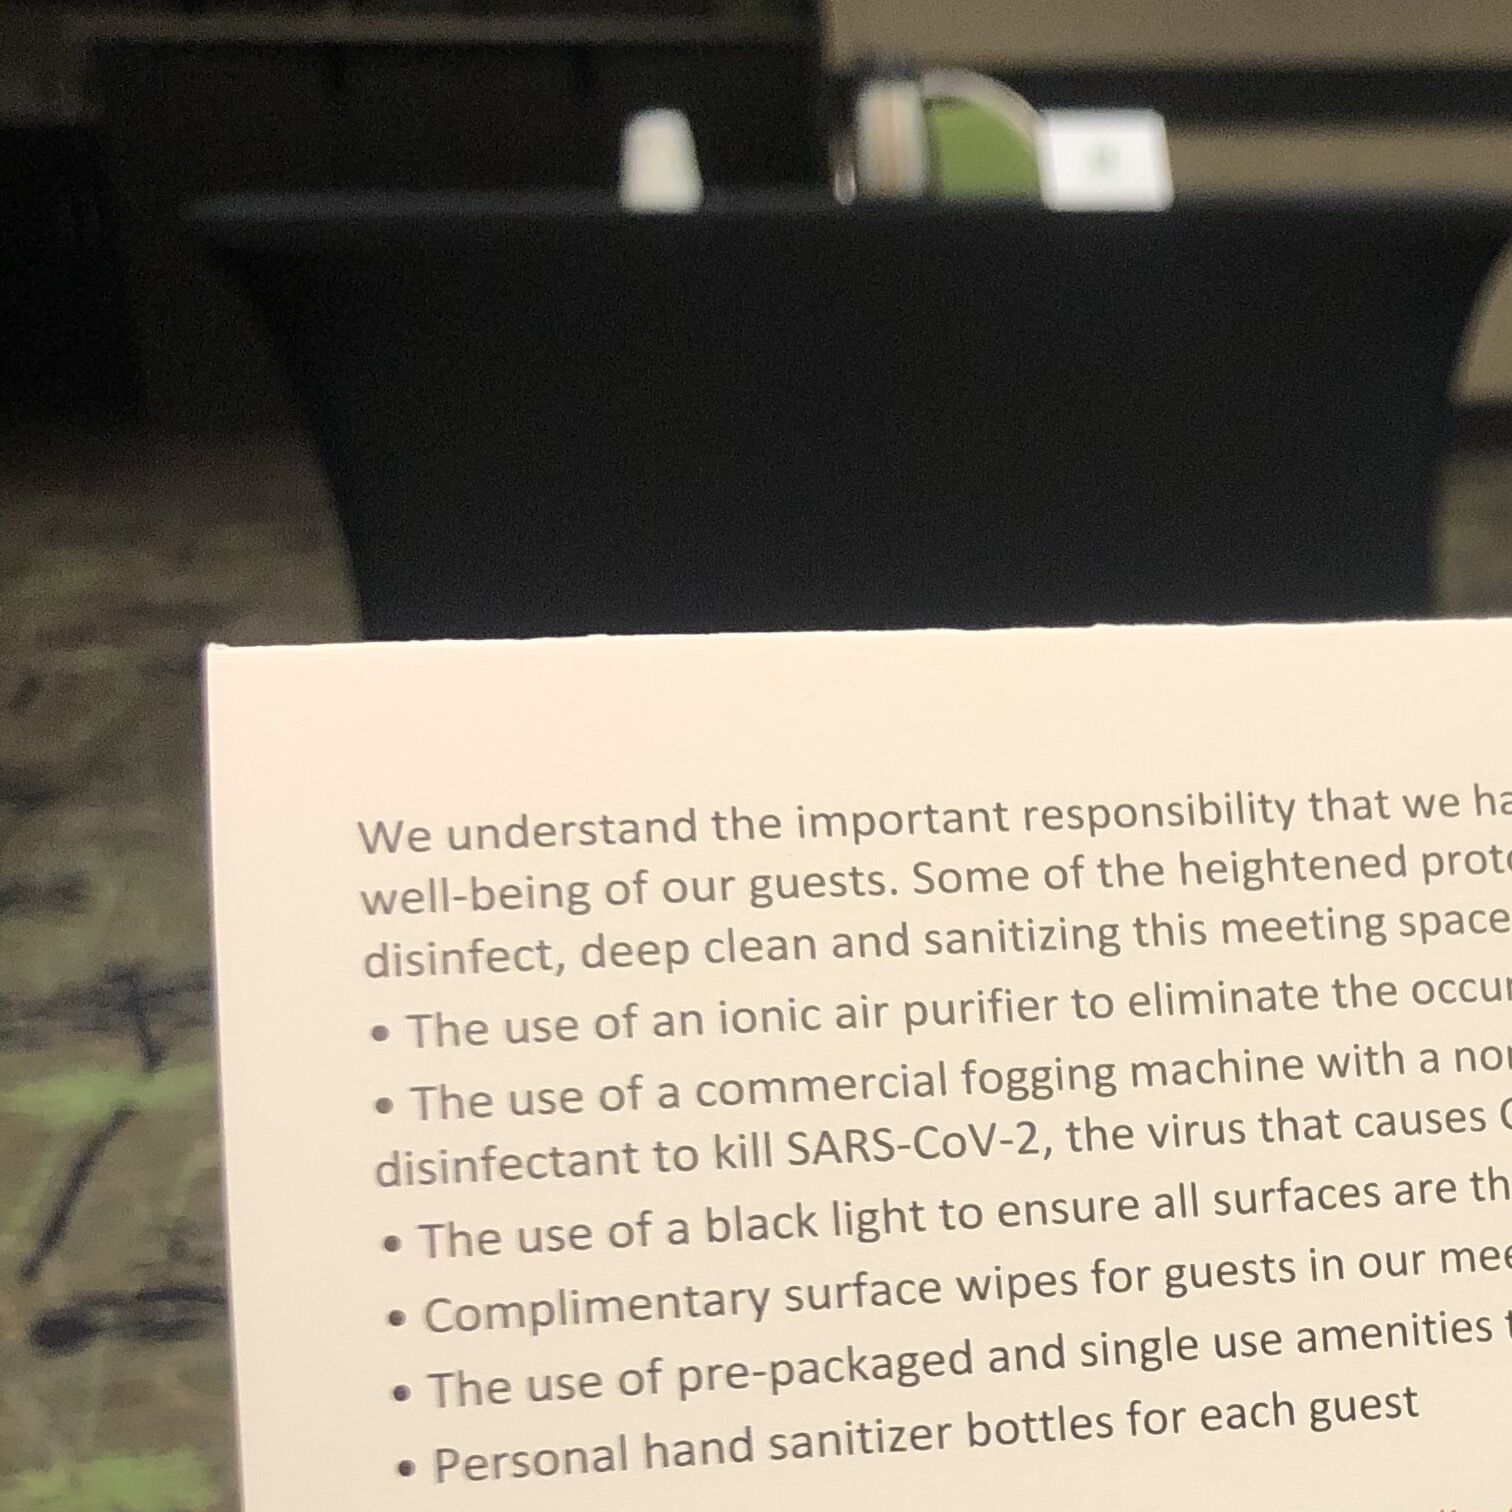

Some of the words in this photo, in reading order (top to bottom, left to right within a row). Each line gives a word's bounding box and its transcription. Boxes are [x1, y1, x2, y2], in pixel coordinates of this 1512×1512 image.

[356, 819, 432, 855] We
[447, 807, 698, 852] understand
[710, 805, 782, 842] the
[796, 801, 1011, 846] important
[1023, 789, 1296, 838] responsibility
[1307, 786, 1392, 823] that
[1401, 792, 1461, 819] we
[359, 874, 592, 916] well-being
[604, 868, 650, 906] of
[661, 875, 737, 904] our
[749, 865, 898, 910] guests.
[912, 860, 1030, 895] Some
[1043, 853, 1086, 891] of
[1095, 852, 1165, 889] the
[1178, 842, 1408, 892] heightened
[404, 1010, 489, 1049] The
[504, 1015, 580, 1045] use
[593, 1001, 640, 1041] of
[652, 1009, 704, 1038] an
[718, 997, 822, 1035] ionic
[835, 993, 890, 1030] air
[903, 986, 1059, 1036] purifier
[1069, 988, 1115, 1020] to
[1128, 979, 1320, 1018] eliminate
[1330, 972, 1398, 1010] the
[374, 1142, 641, 1188] disinfectant
[651, 1140, 700, 1173] to
[712, 1130, 773, 1171] kill
[787, 1120, 1053, 1167] SARS-CoV-2,
[1064, 1115, 1135, 1153] the
[1146, 1112, 1247, 1149] virus
[1257, 1106, 1343, 1144] that
[1354, 1106, 1487, 1139] causes
[421, 1285, 771, 1337] Complimentary
[784, 1270, 942, 1313] surface
[954, 1264, 1079, 1309] wipes
[1089, 1257, 1152, 1295] for
[1164, 1253, 1297, 1299] guests
[1309, 1246, 1345, 1283] in
[1358, 1249, 1427, 1279] our
